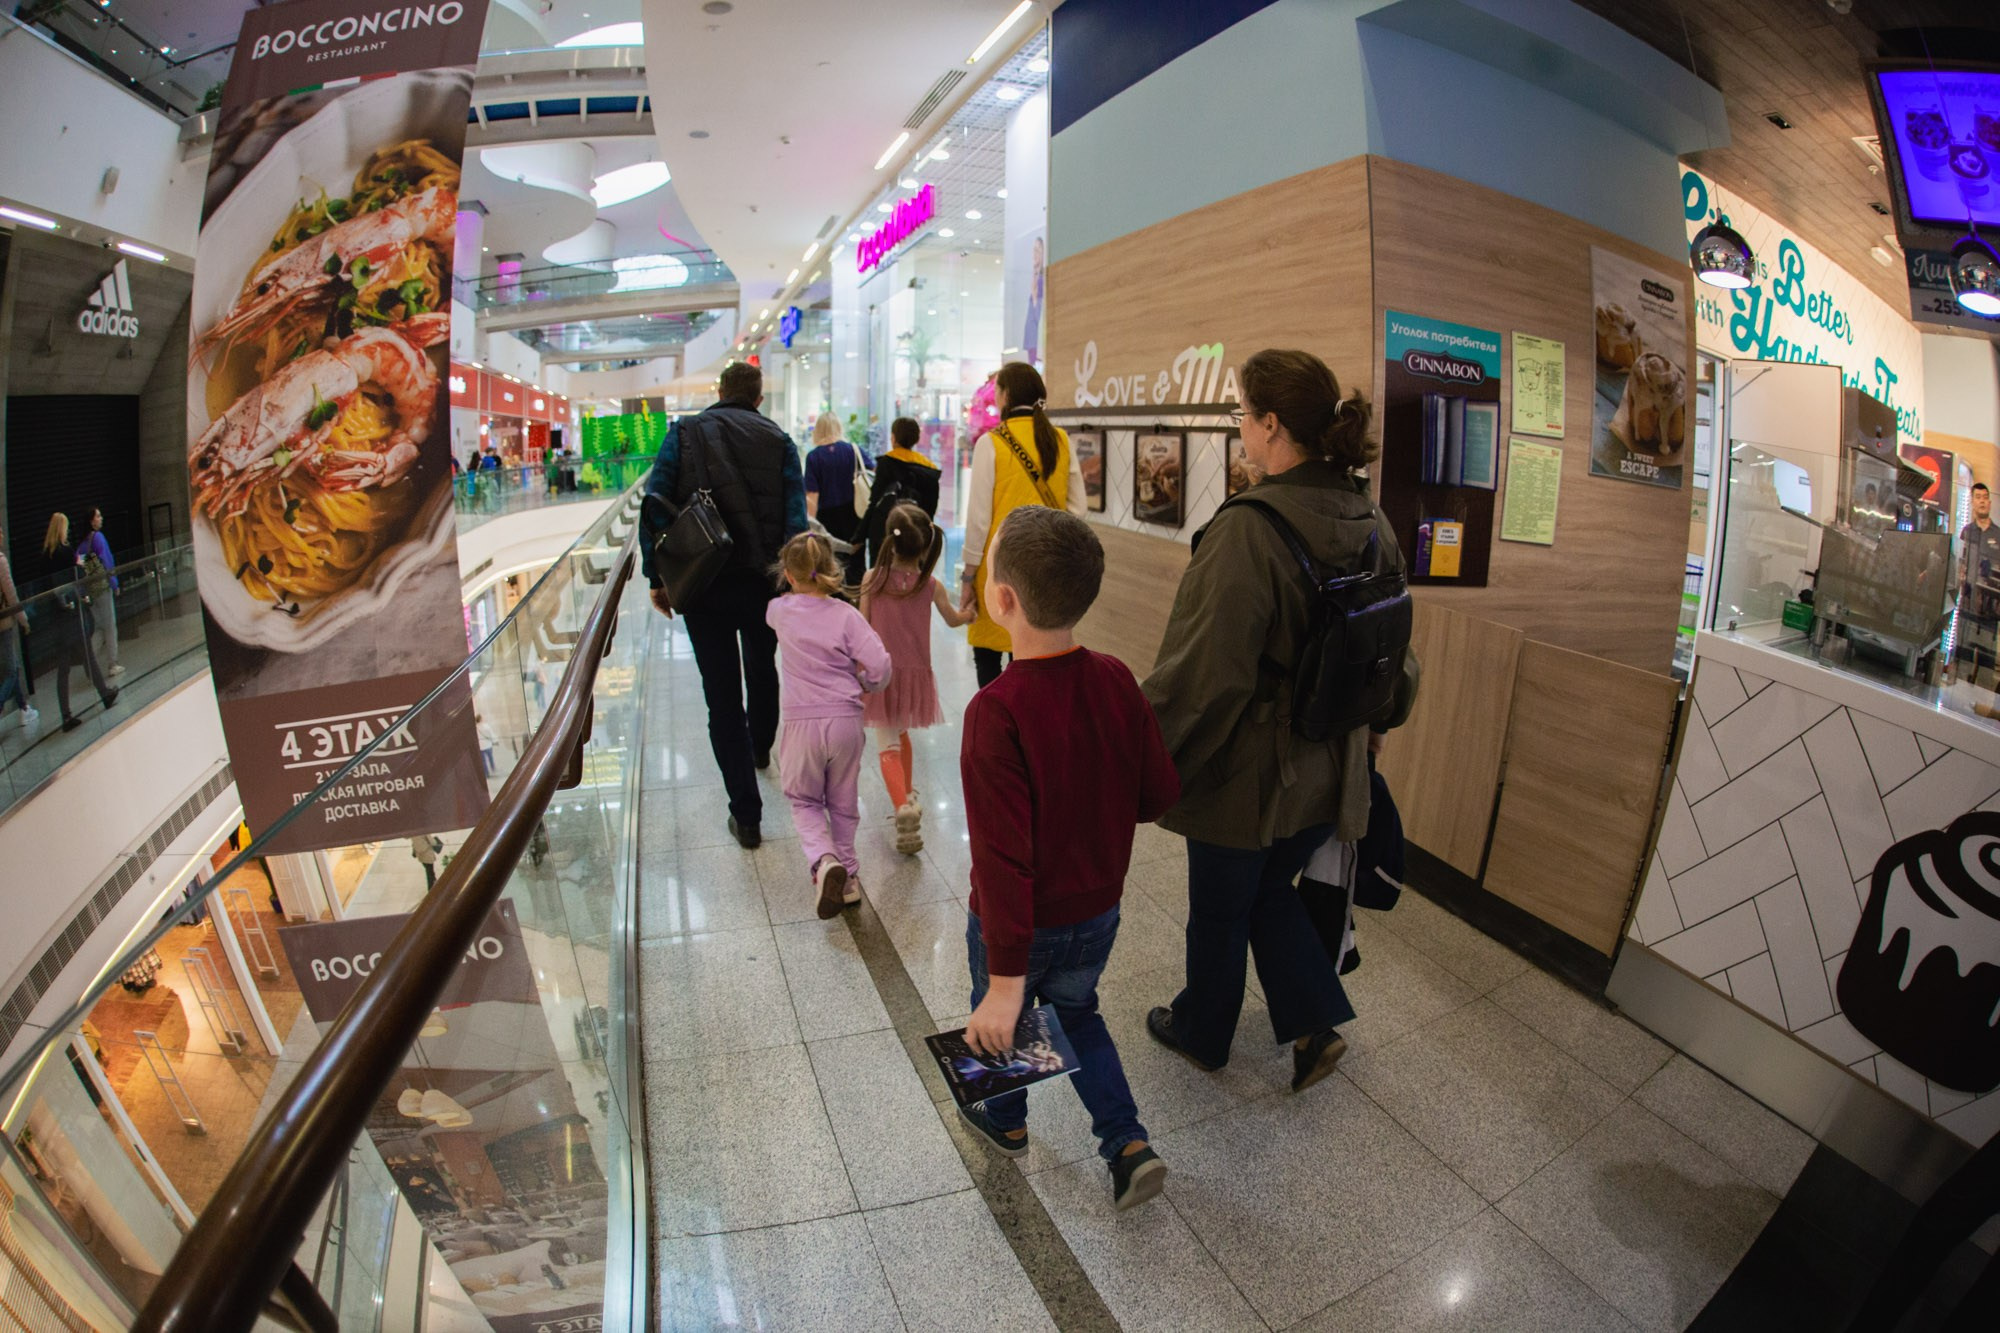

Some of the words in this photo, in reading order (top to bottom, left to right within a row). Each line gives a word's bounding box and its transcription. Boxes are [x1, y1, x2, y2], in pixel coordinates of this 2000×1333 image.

[252, 2, 464, 60] BOCCONCINO
[307, 41, 387, 63] RESTAURANT
[1773, 239, 1854, 346] Better
[79, 306, 139, 338] adidas
[1391, 322, 1429, 340] Уголок
[1431, 332, 1497, 353] потребителя
[1152, 370, 1171, 405] &
[1172, 342, 1241, 405] MA
[1408, 353, 1480, 381] CINNABON
[1875, 356, 1920, 441] Teats
[999, 424, 1040, 482] WOODST
[1620, 460, 1659, 479] ESCAPE
[281, 731, 302, 761] 4
[308, 715, 416, 758] ЭТАЖ
[315, 771, 325, 784] 2
[356, 775, 425, 797] ИГРОВАЯ
[325, 799, 400, 823] ДОСТАВКА
